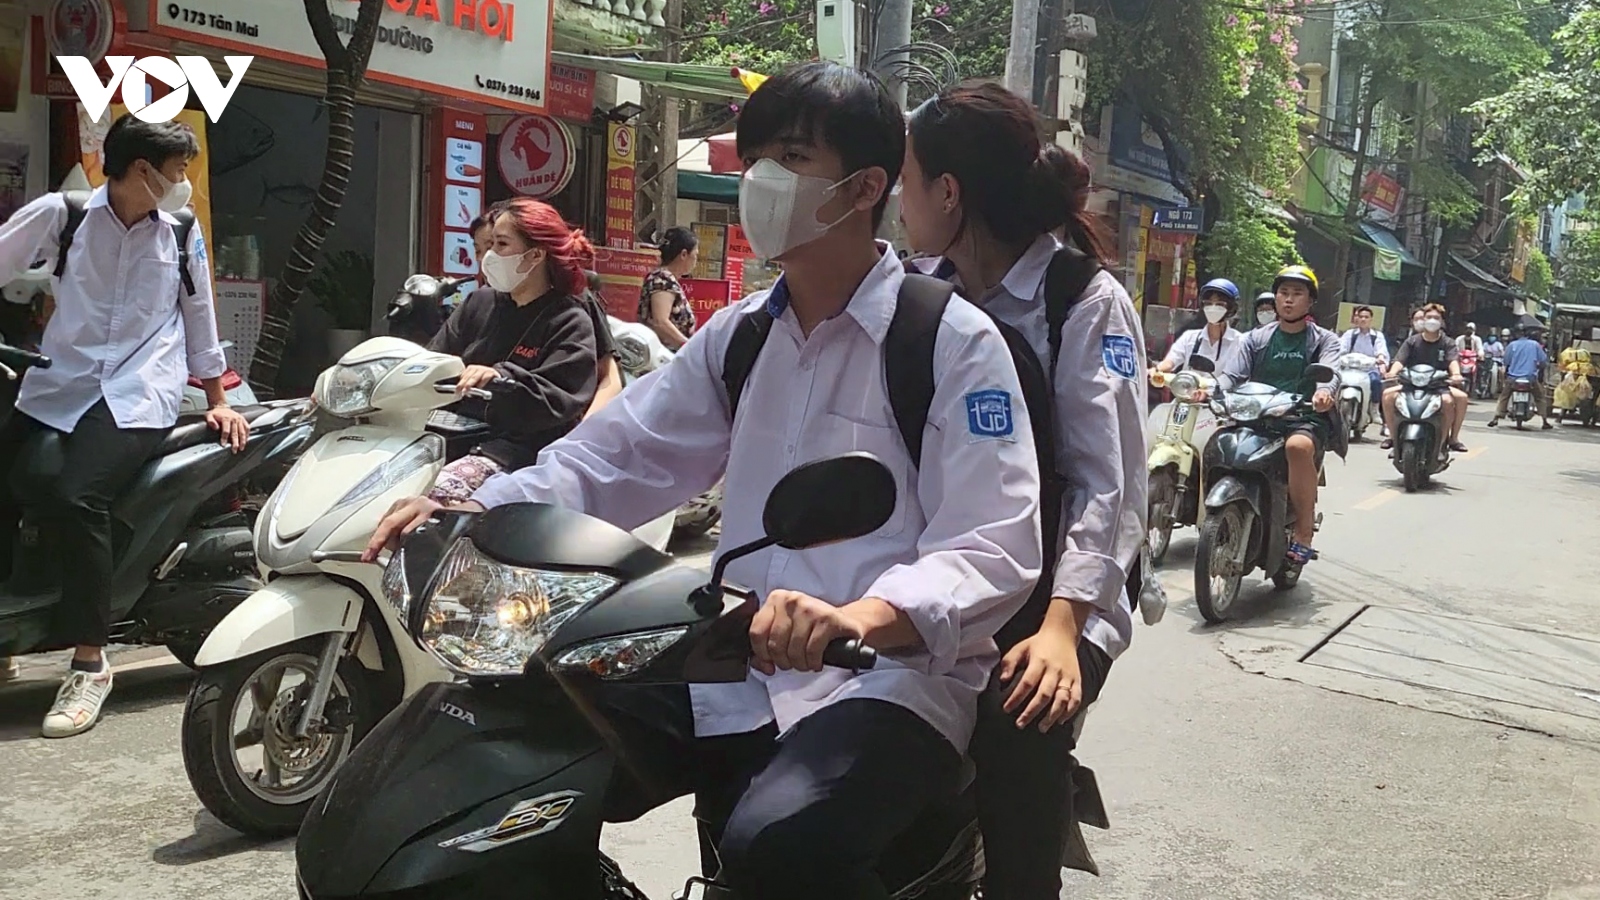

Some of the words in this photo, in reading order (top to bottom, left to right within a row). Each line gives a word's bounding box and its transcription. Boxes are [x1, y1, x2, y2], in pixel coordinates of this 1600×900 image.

[183, 9, 206, 26] 173
[208, 14, 232, 32] Tân
[236, 21, 259, 38] Mai
[486, 79, 507, 93] 0376
[508, 84, 523, 97] 238
[525, 88, 540, 100] 968
[455, 119, 474, 131] MENU
[1182, 211, 1193, 220] 173
